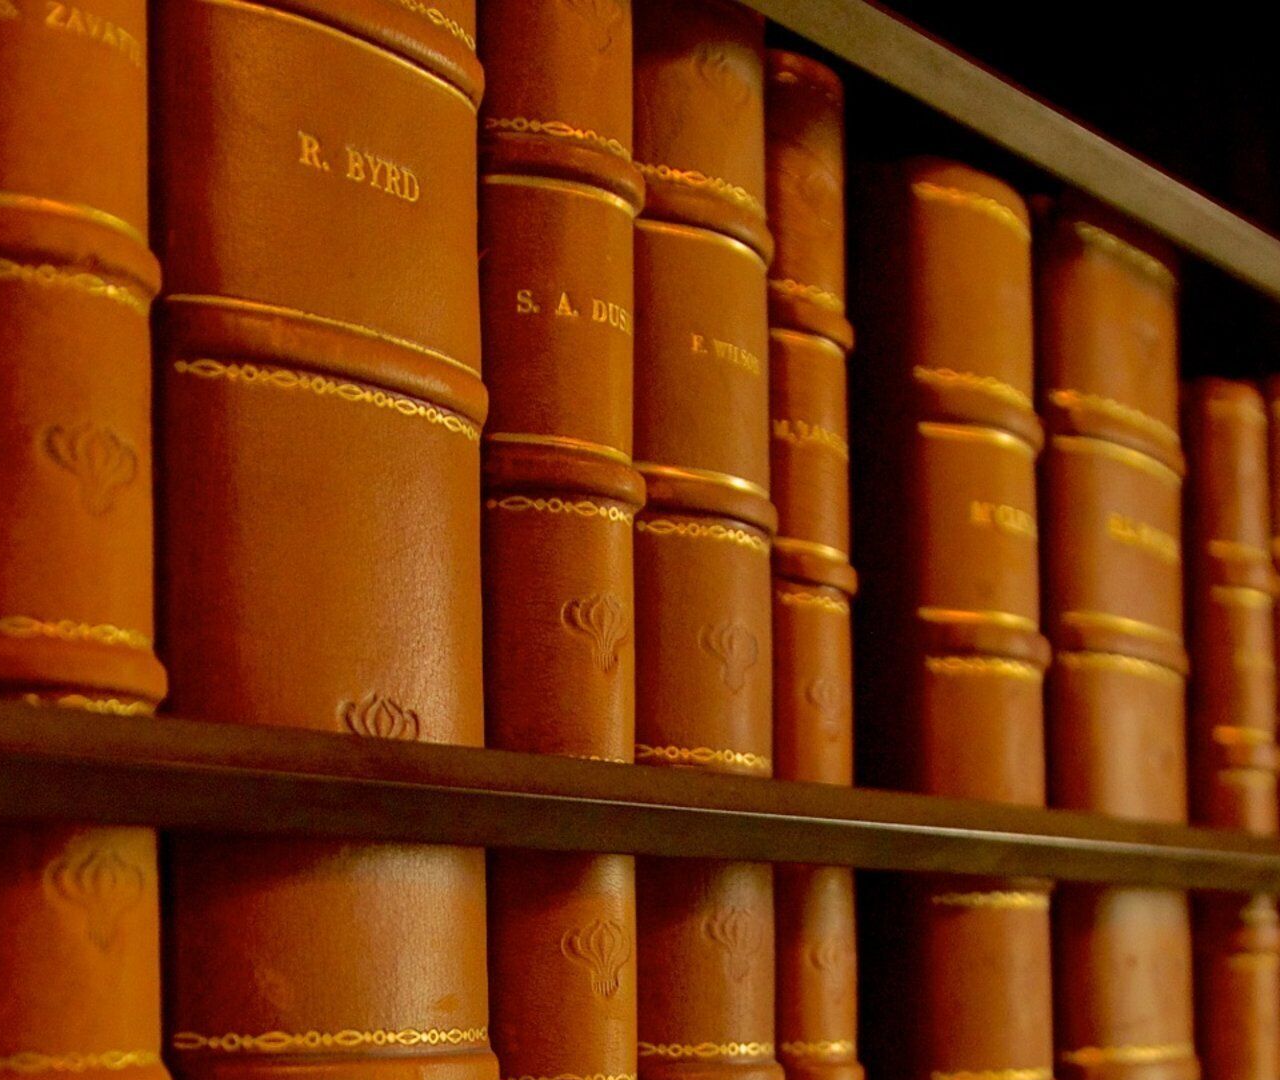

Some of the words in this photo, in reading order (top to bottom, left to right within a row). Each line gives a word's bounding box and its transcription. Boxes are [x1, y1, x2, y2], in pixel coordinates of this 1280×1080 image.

[298, 131, 331, 171] R.
[346, 145, 420, 203] BYRD
[516, 289, 540, 314] S.
[555, 291, 579, 318] A.
